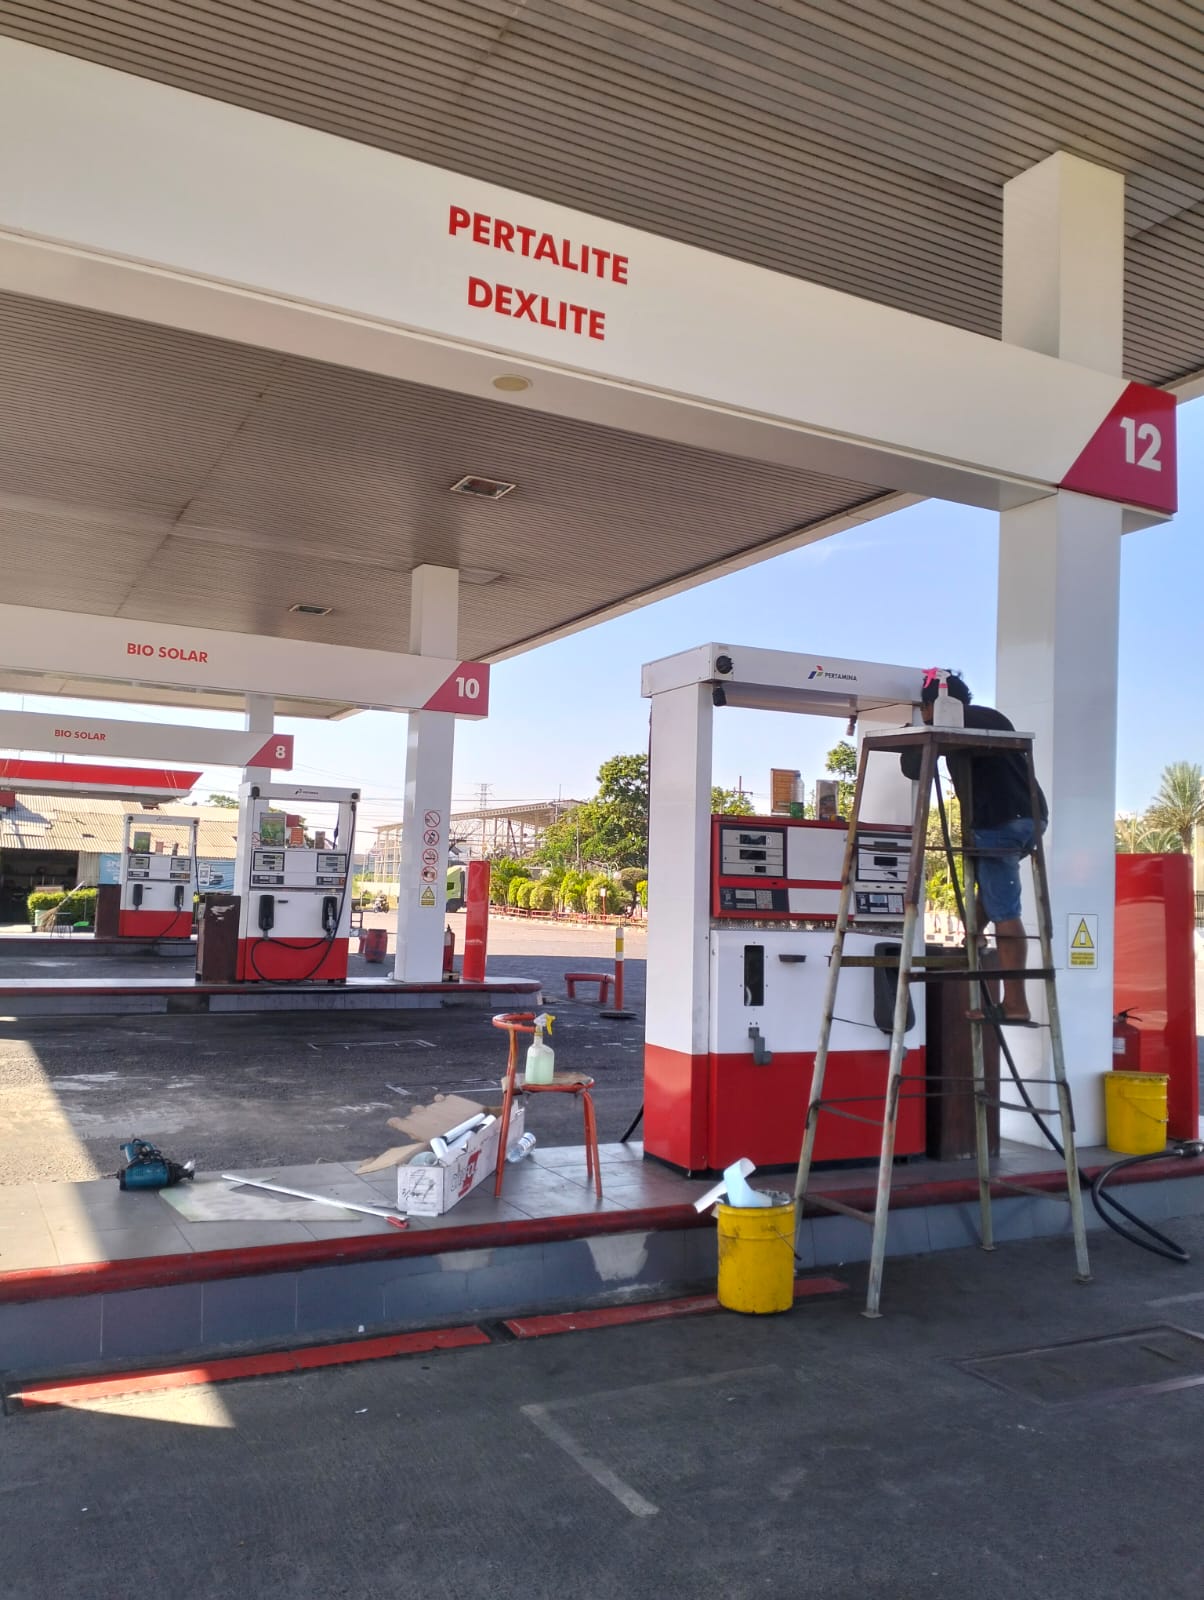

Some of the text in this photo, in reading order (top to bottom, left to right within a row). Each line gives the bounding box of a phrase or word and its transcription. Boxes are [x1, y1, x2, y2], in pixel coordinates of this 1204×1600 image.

[448, 204, 629, 285] PERTALITE
[467, 275, 606, 341] DEXLITE
[1119, 416, 1162, 472] 12
[127, 642, 208, 663] BIO SOLAR
[824, 671, 858, 681] PERTAMINA
[455, 676, 480, 699] 10
[54, 729, 106, 741] BIO SOLAR
[275, 745, 286, 759] 8
